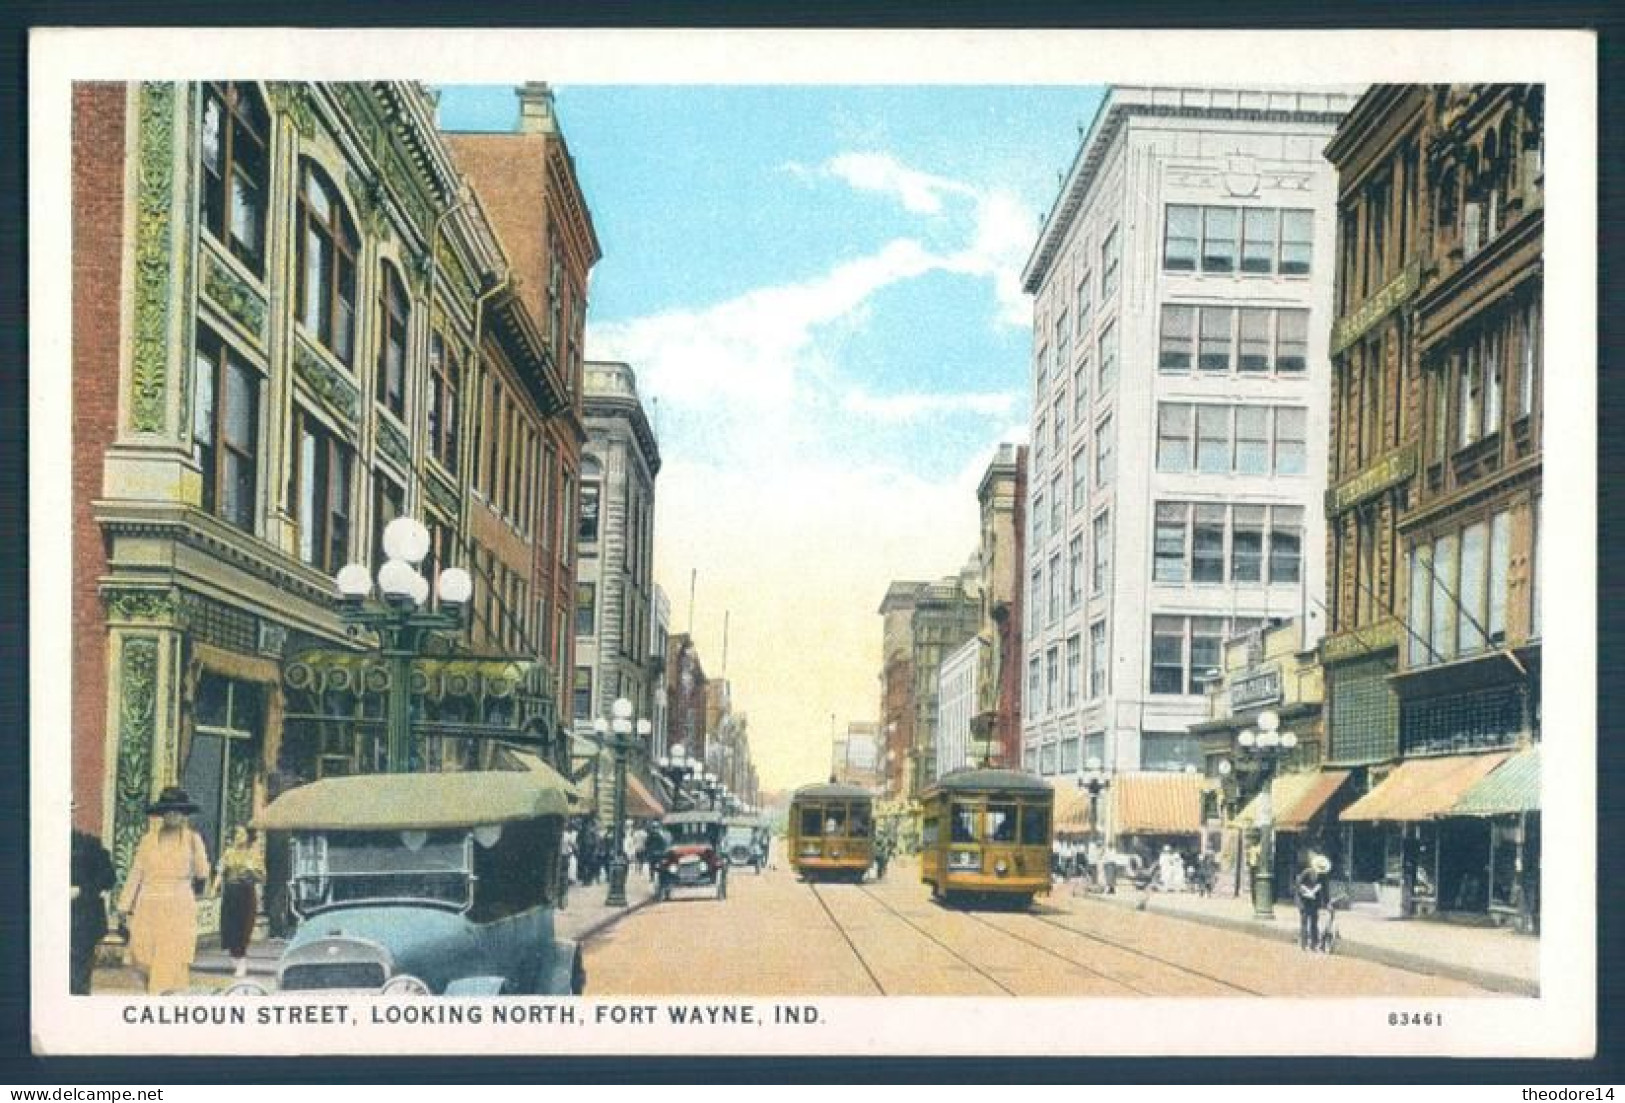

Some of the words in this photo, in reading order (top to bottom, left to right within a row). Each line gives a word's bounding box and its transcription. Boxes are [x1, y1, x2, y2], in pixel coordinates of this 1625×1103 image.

[123, 1005, 246, 1024] CALHOUN
[257, 1005, 357, 1025] STREET,
[371, 1005, 482, 1024] LOOKING
[492, 1005, 584, 1025] NORTH,
[595, 1005, 657, 1024] FORT
[668, 1005, 762, 1025] WAYNE,
[775, 1005, 826, 1024] IND.
[1388, 1011, 1444, 1027] 83461
